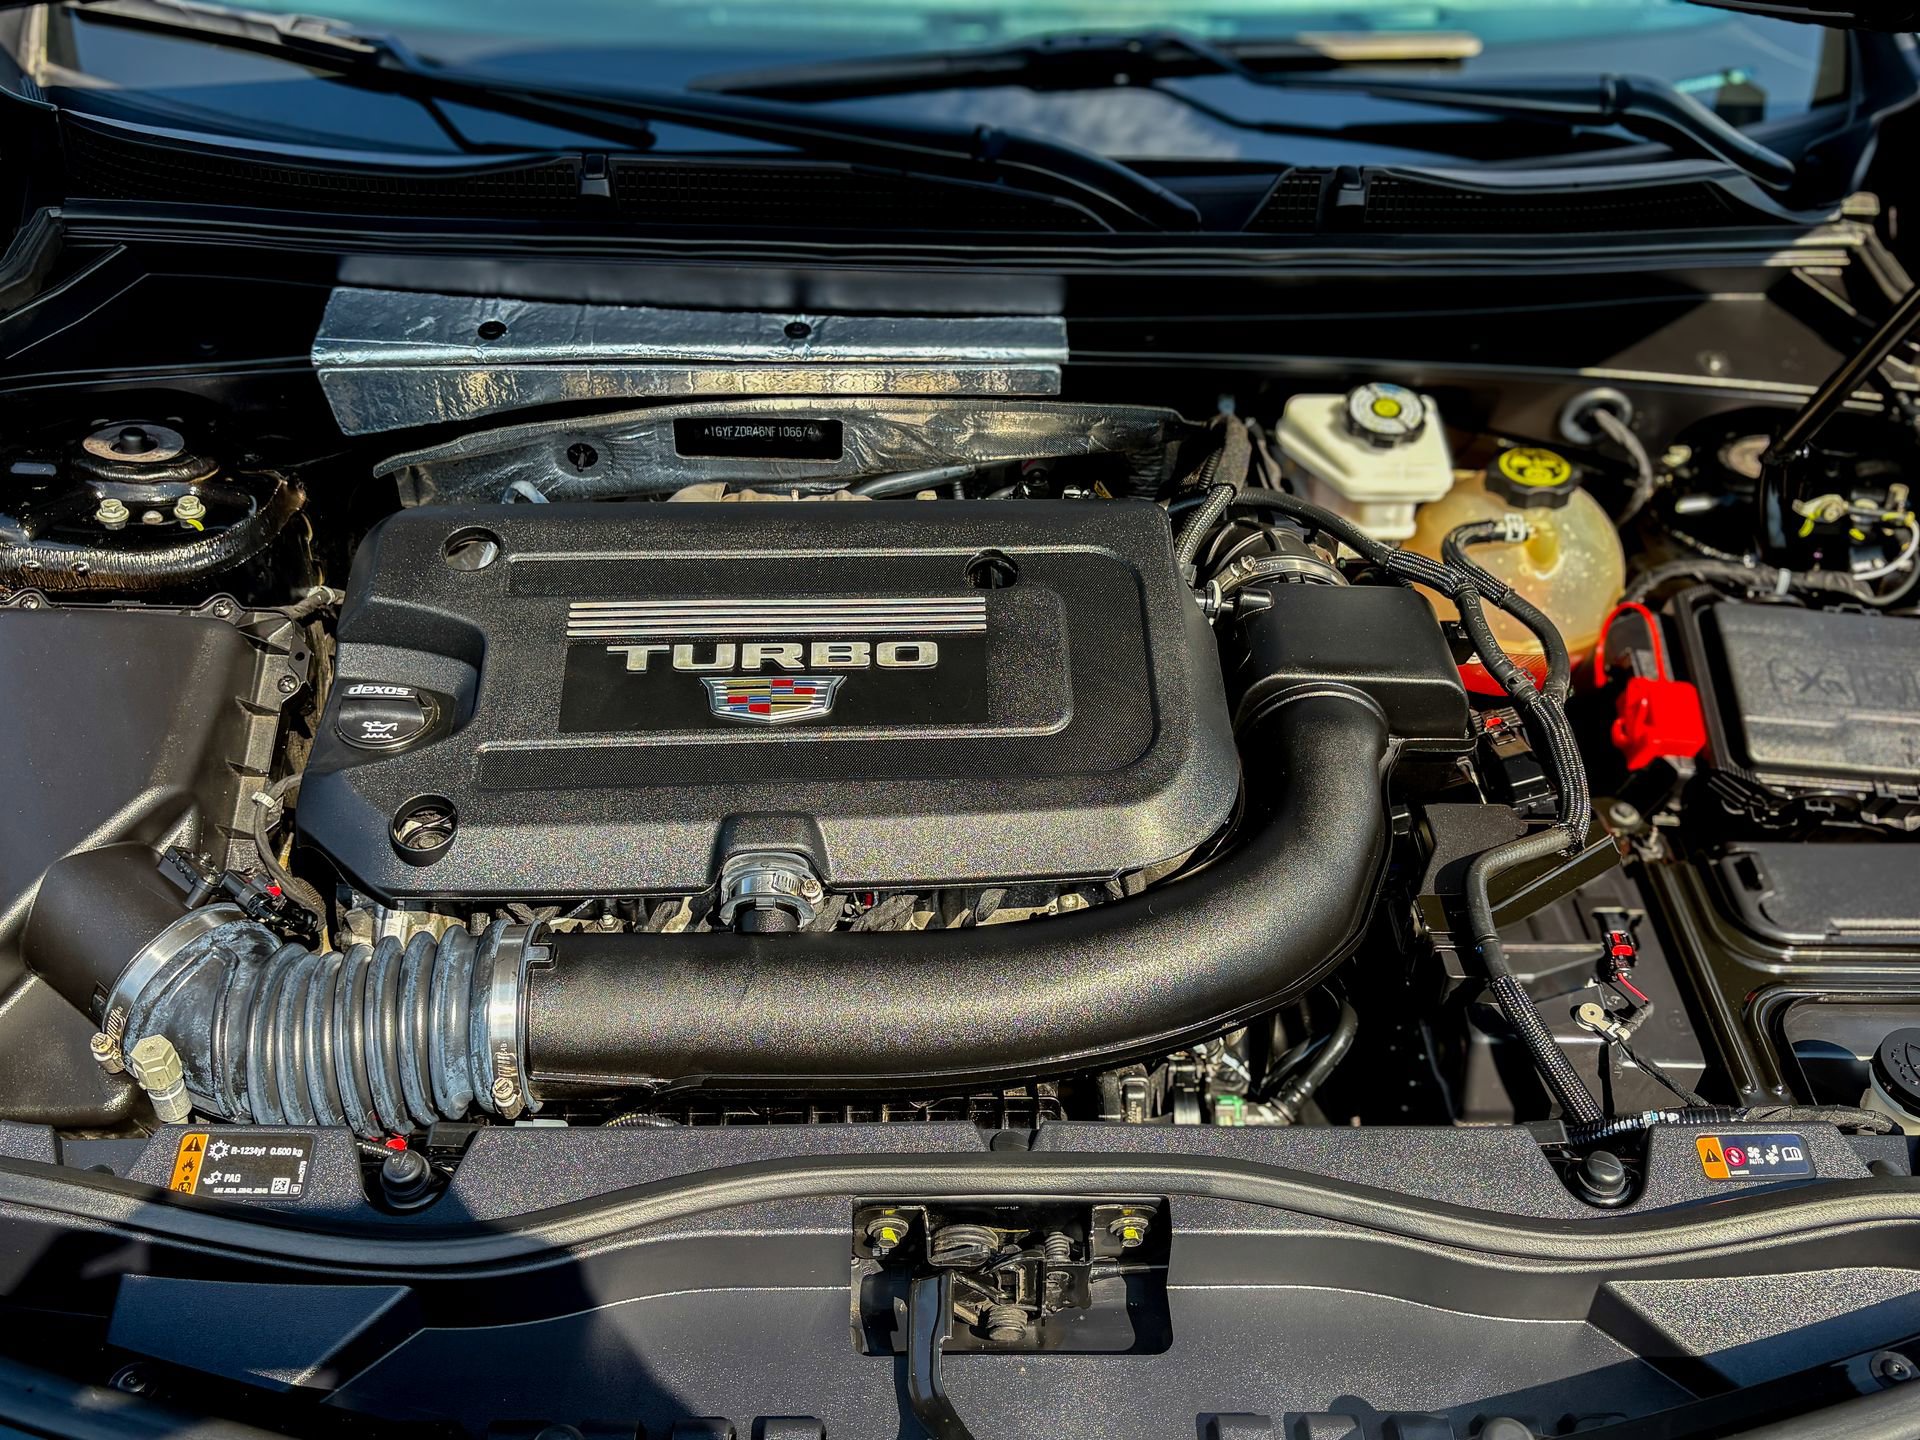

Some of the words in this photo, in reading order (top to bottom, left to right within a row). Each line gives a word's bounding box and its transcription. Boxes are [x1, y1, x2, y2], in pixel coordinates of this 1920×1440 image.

[606, 641, 938, 672] TURBO
[348, 684, 412, 696] dexos
[231, 1147, 266, 1157] R-1234yf
[293, 1147, 304, 1158] kg
[224, 1174, 241, 1183] PAG
